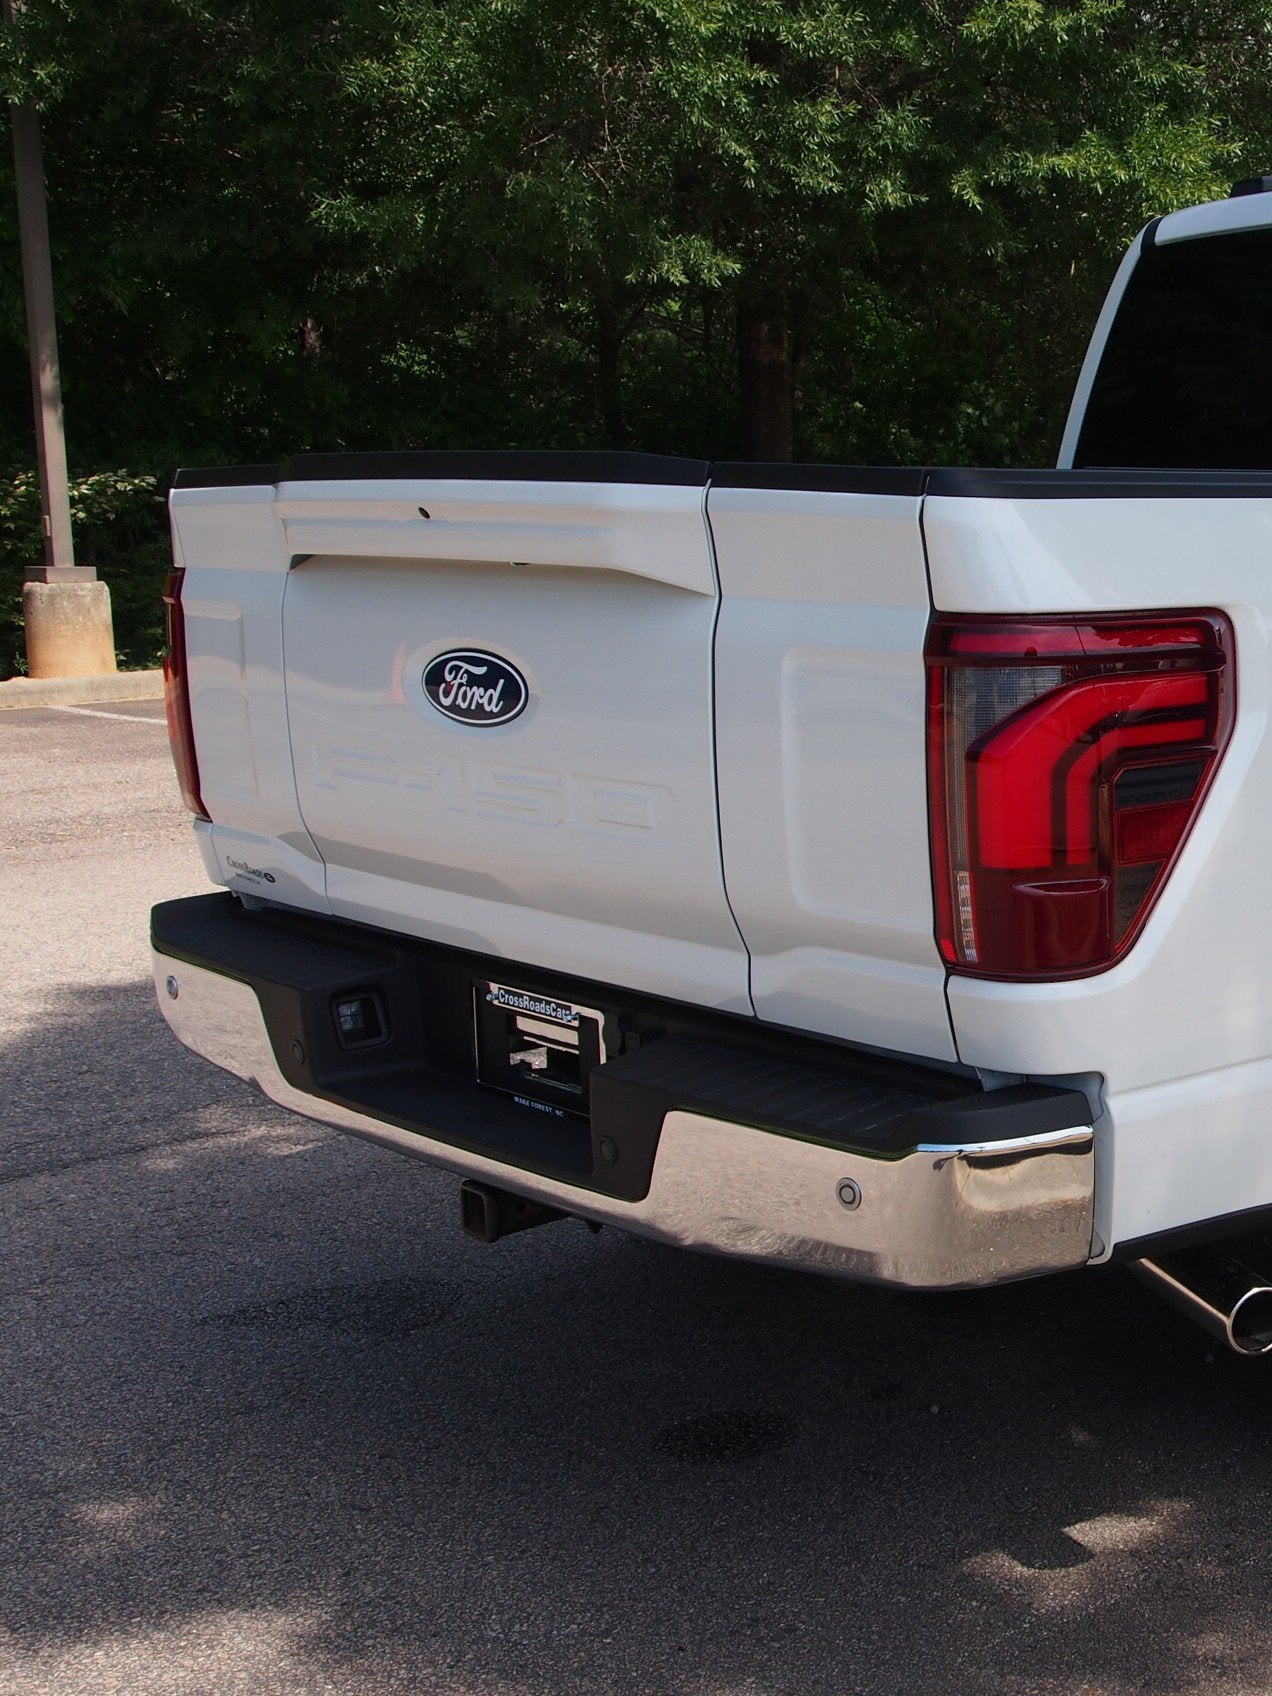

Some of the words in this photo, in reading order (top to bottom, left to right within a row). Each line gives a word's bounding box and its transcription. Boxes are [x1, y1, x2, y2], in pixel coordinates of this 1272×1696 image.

[439, 660, 505, 713] Ford
[513, 1095, 530, 1107] WAKE
[555, 1109, 564, 1117] NC
